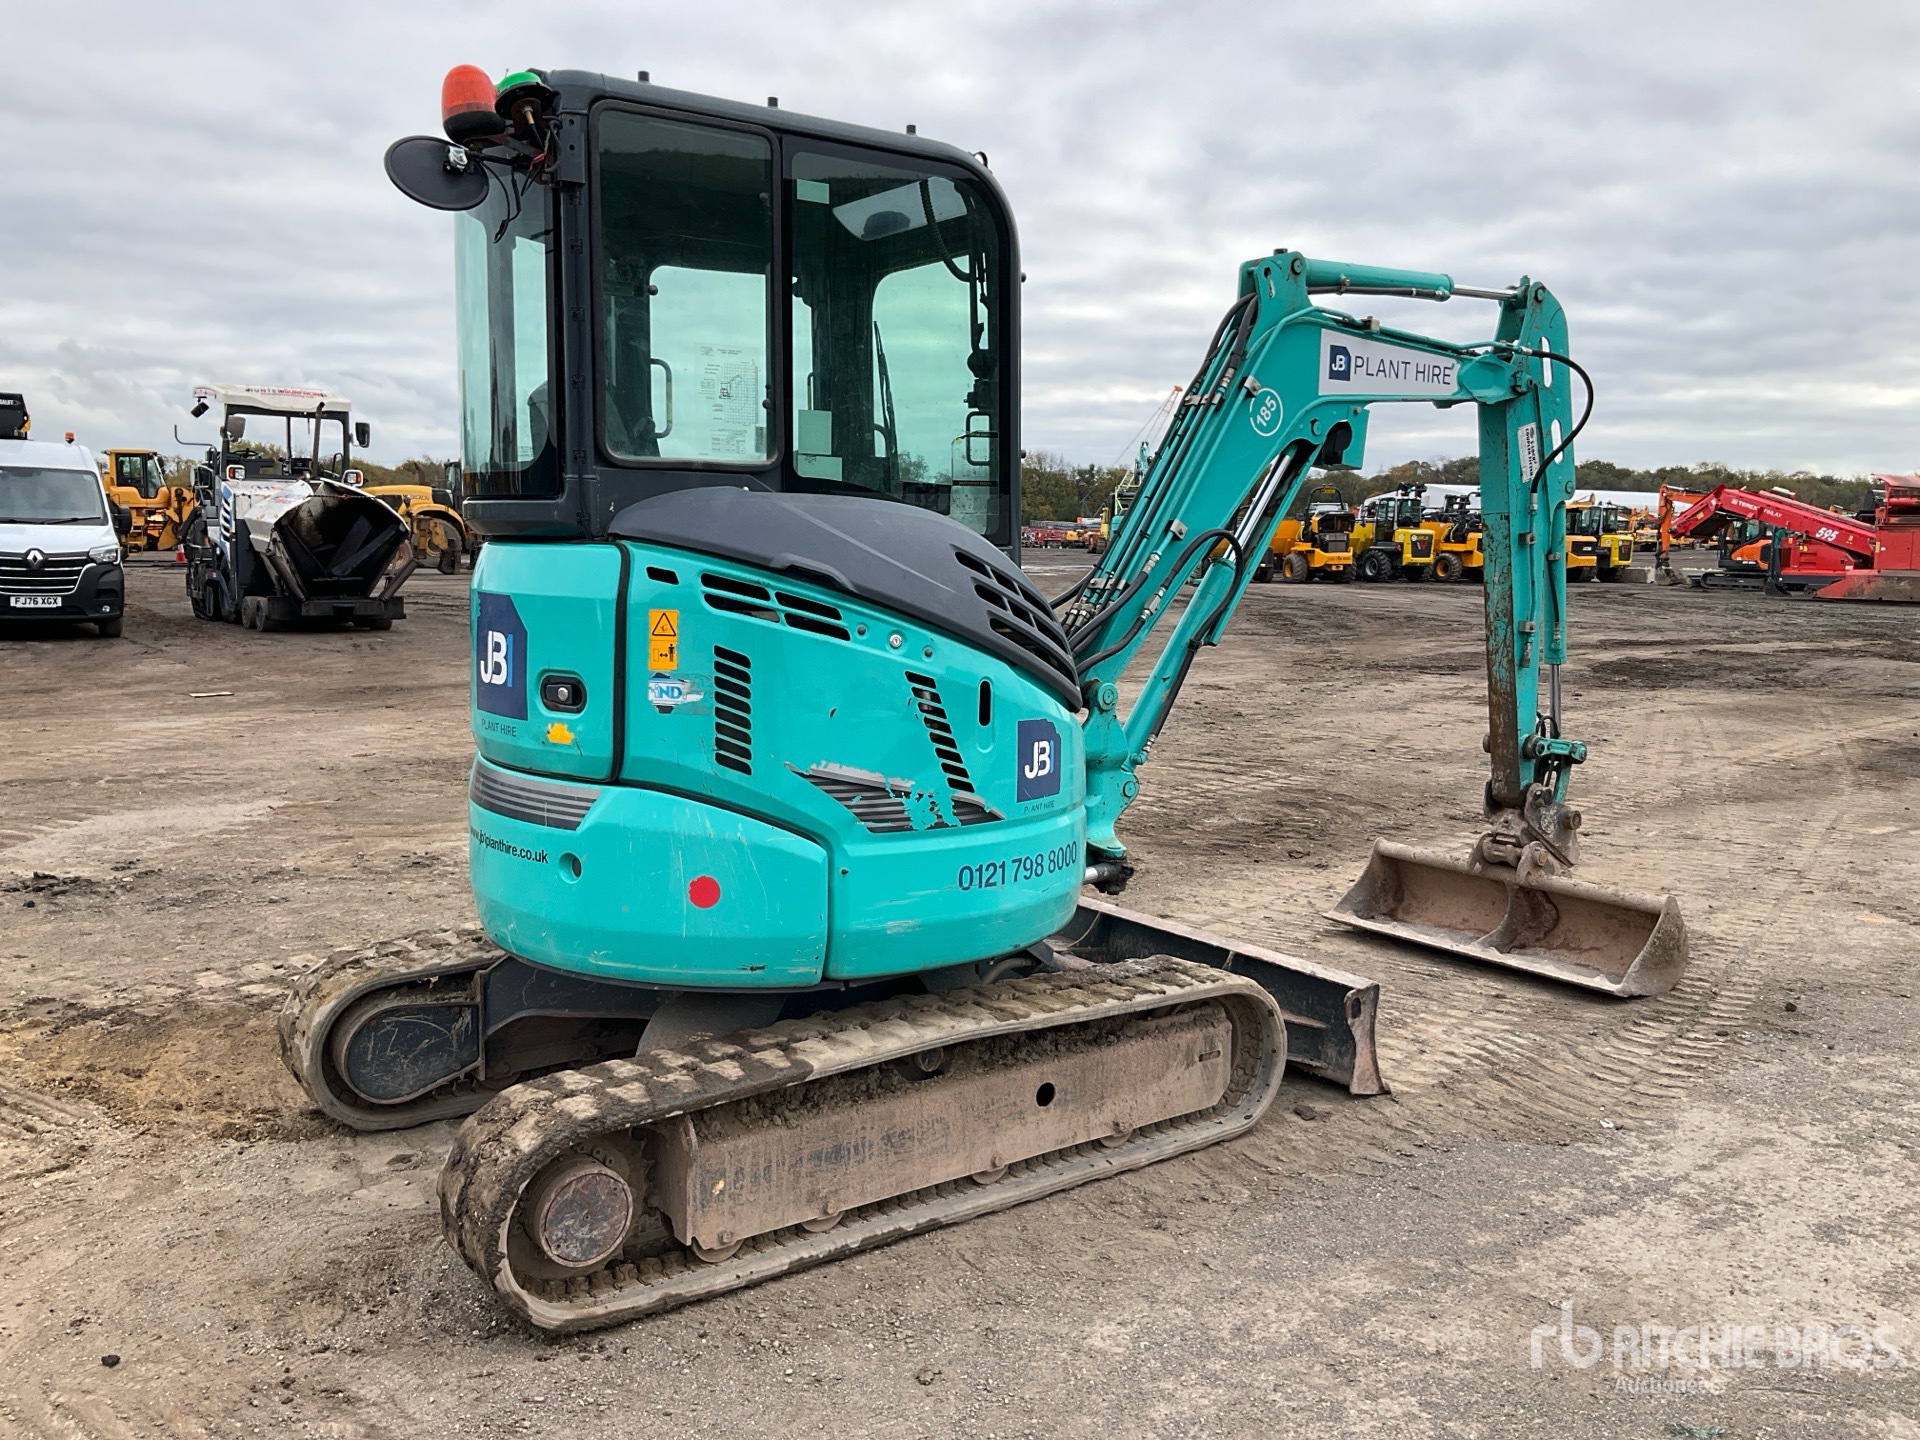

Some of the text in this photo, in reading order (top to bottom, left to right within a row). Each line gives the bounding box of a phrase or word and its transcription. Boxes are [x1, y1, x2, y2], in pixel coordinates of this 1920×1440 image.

[1354, 355, 1410, 380] PLANT
[1415, 362, 1451, 385] HIRE
[1256, 396, 1277, 427] 185
[1738, 500, 1783, 518] TEREX FINLAY
[1815, 527, 1839, 542] 595
[15, 597, 58, 605] FJ76 XGX
[481, 718, 517, 738] PLANT HIRE
[958, 840, 1077, 890] 0121 798 8000
